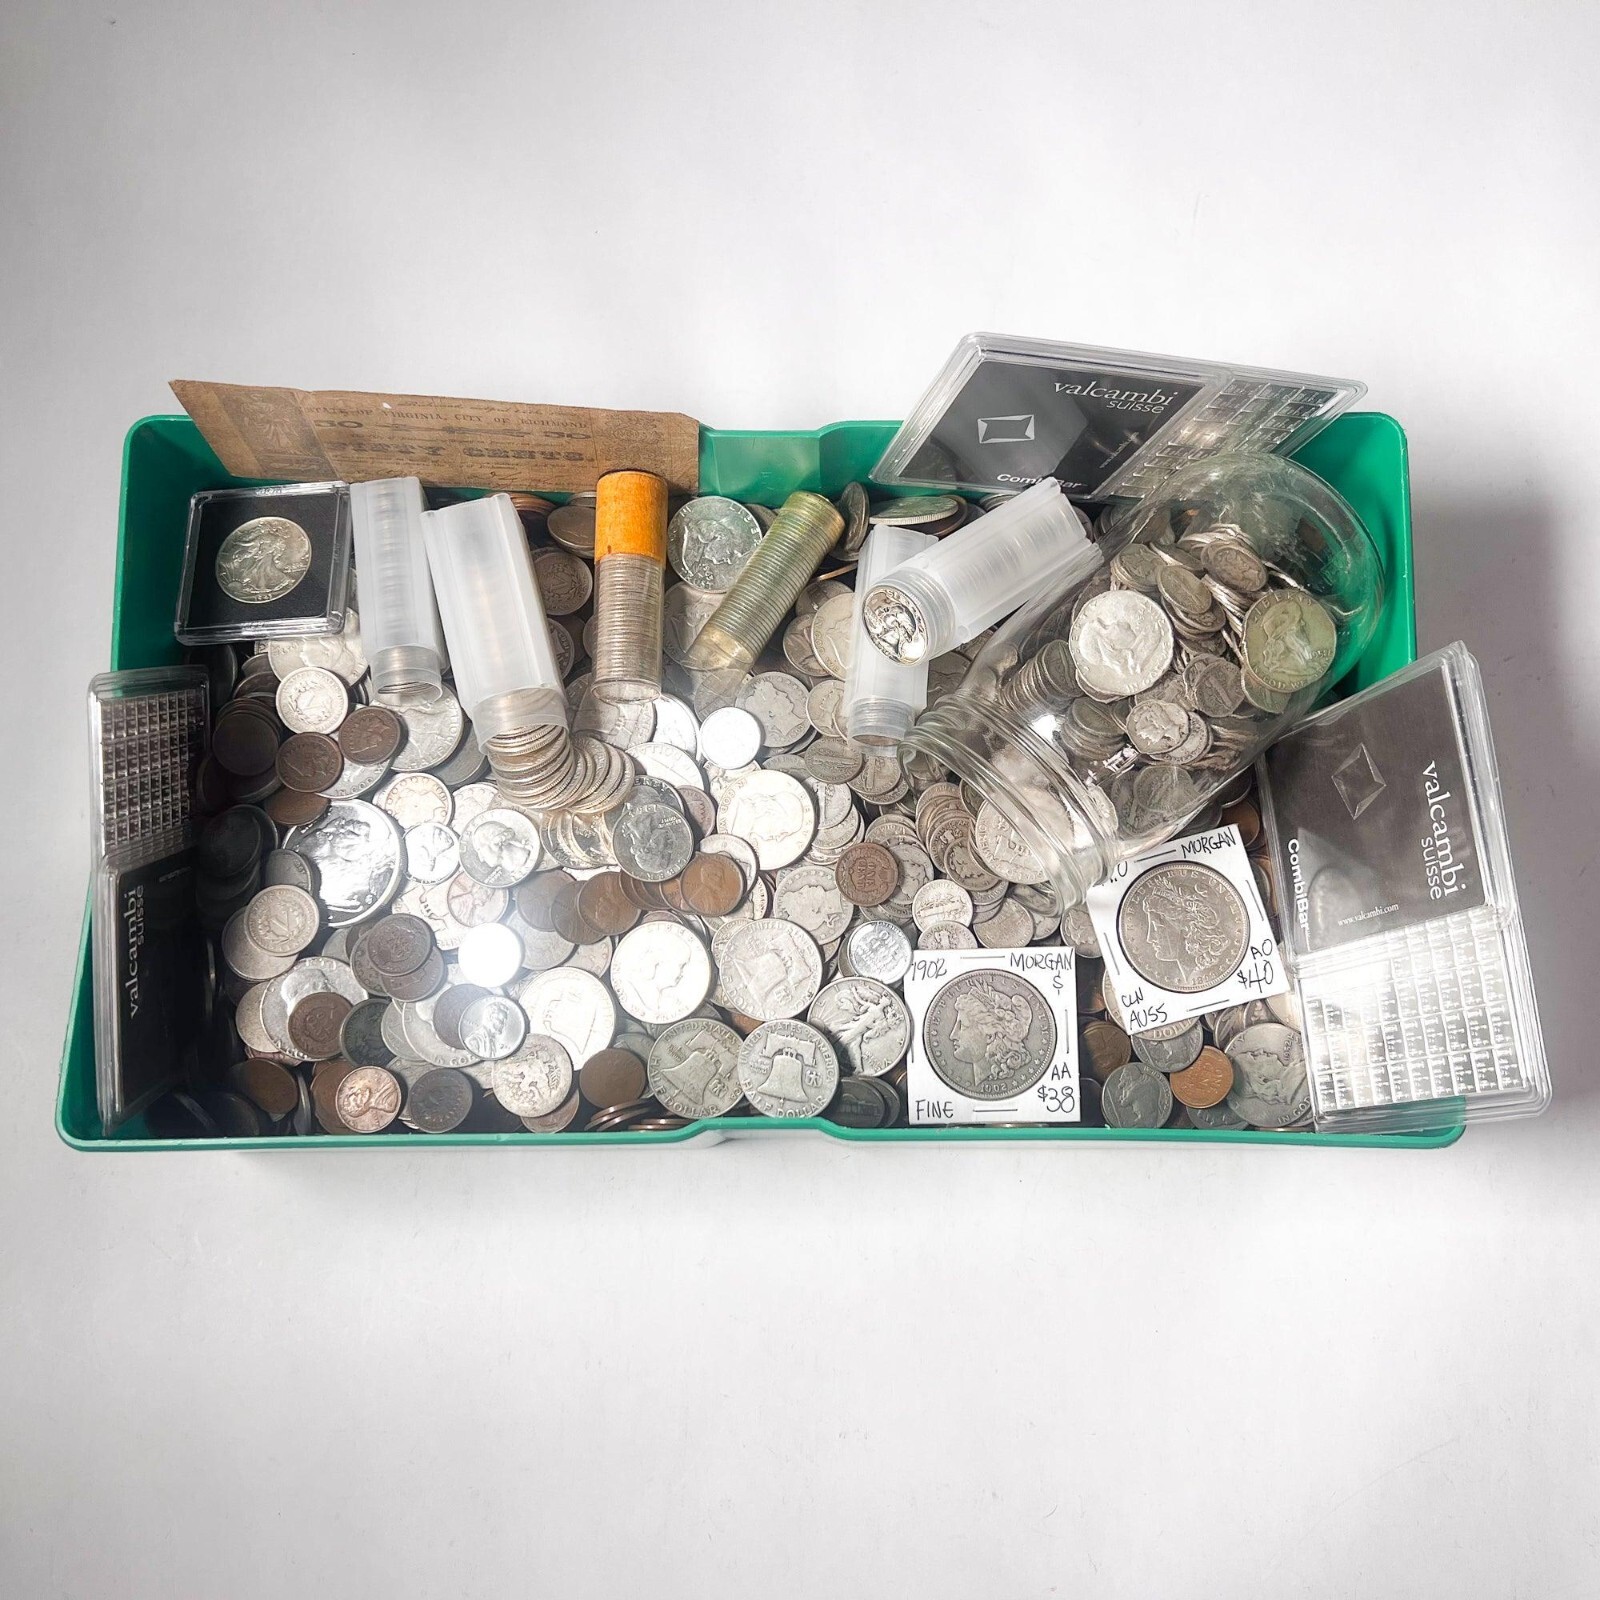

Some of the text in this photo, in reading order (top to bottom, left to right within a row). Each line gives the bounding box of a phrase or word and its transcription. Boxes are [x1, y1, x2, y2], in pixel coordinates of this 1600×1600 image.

[1053, 380, 1179, 406] valcambi
[1106, 400, 1165, 414] suisse
[455, 413, 481, 422] CITY
[521, 418, 588, 428] RICHMOND
[996, 473, 1082, 489] ComBar
[1181, 828, 1237, 858] MORGAN
[1422, 760, 1467, 897] valcambi
[1287, 838, 1310, 929] CombiBar
[1421, 837, 1443, 900] suisse
[136, 884, 145, 946] suisse
[123, 888, 139, 1020] valcambi
[911, 948, 1074, 982] 1902 MORGAN
[1052, 970, 1064, 996] $
[1236, 960, 1275, 994] $40
[1050, 1061, 1072, 1081] AA
[915, 1098, 954, 1121] FINE
[1036, 1084, 1075, 1114] $38
